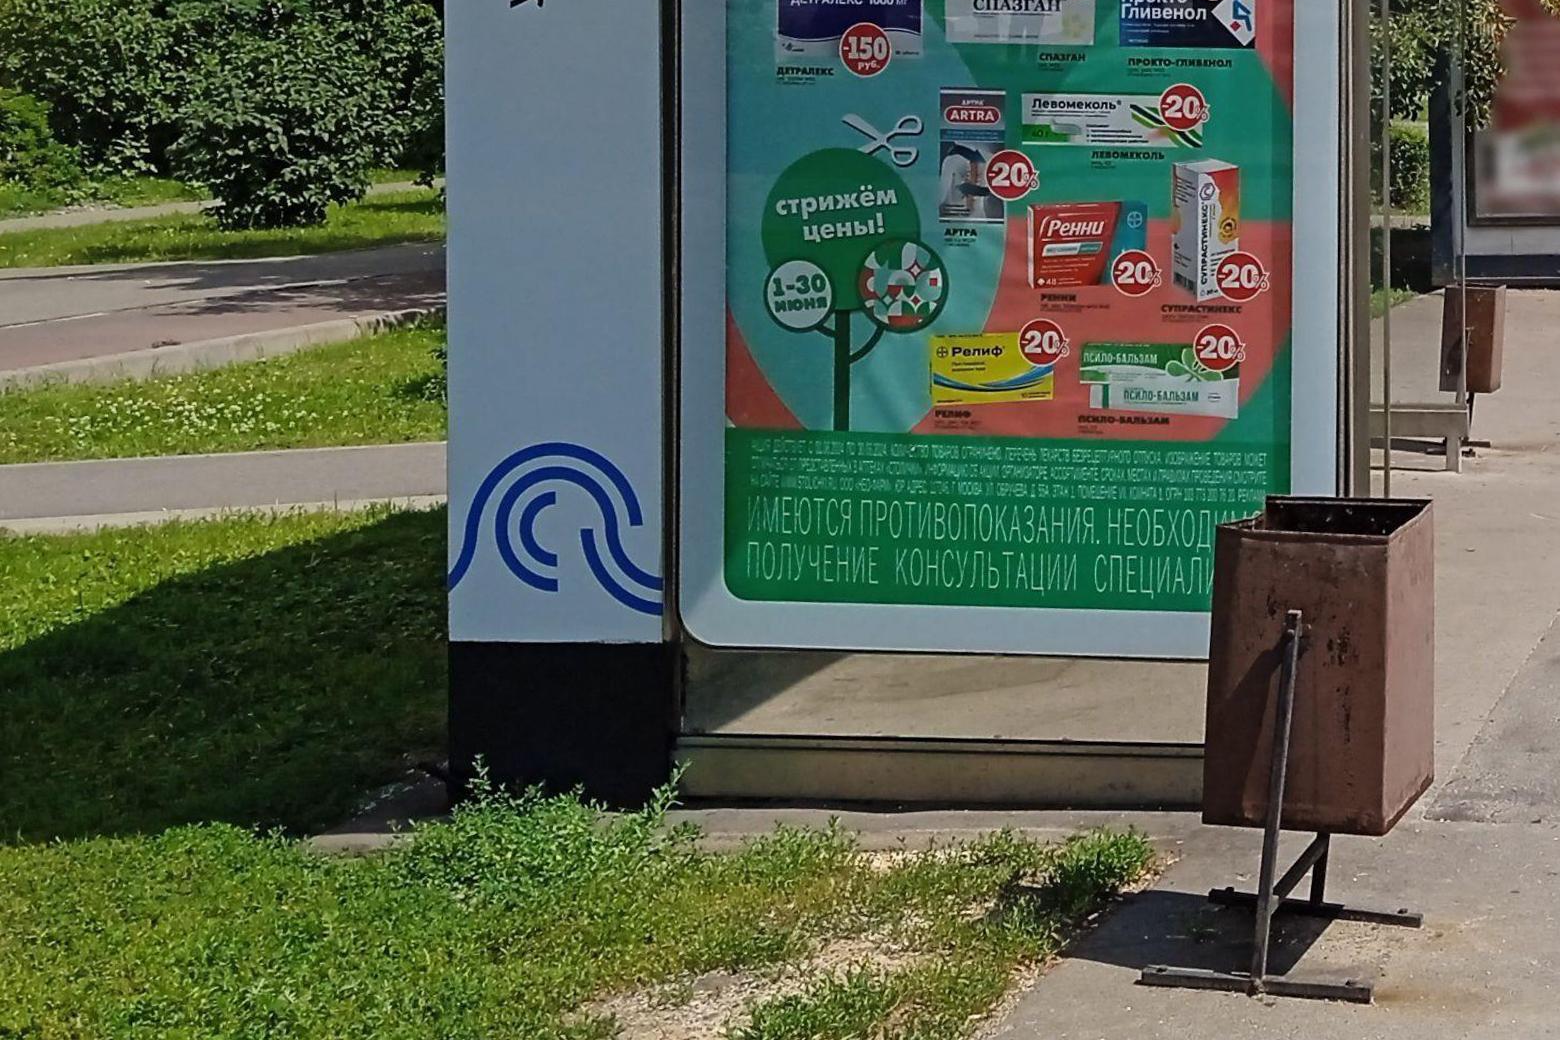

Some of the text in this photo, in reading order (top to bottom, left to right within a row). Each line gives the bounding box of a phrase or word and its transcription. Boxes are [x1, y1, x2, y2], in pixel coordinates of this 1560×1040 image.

[1121, 3, 1207, 20] Гливенол
[843, 36, 888, 60] -150
[1039, 52, 1086, 62] СПАЗГАН
[777, 66, 834, 76] ДЕТРАЛЕКС
[858, 60, 881, 70] руб.
[950, 110, 995, 121] ARTRA
[1161, 94, 1210, 122] -20%
[1091, 151, 1165, 160] ЛЕВОМЕКОЛЬ
[988, 161, 1040, 189] -20%
[775, 184, 898, 220] стрижём
[802, 212, 886, 243] цены!
[944, 228, 977, 237] АРТРА
[1047, 220, 1105, 237] Ренни
[772, 274, 827, 297] 1-30
[1114, 261, 1162, 288] -20%
[1217, 264, 1270, 292] -20%
[951, 346, 1003, 358] Релиф
[1021, 330, 1070, 357] -20%
[1197, 335, 1246, 361] -20%
[1083, 351, 1157, 364] ПСИЛО-БАЛЬЗАМ
[1123, 389, 1199, 402] ПСИЛО-БАЛЬЗАМ
[747, 496, 1262, 552] ИМЕЮТСЯ ПРОТИВОПОКАЗАНИЯ. НЕОБХОД
[747, 542, 880, 584] ПОЛУЧЕНИЕ
[895, 548, 1077, 596] КОНСУЛЬТАЦИИ
